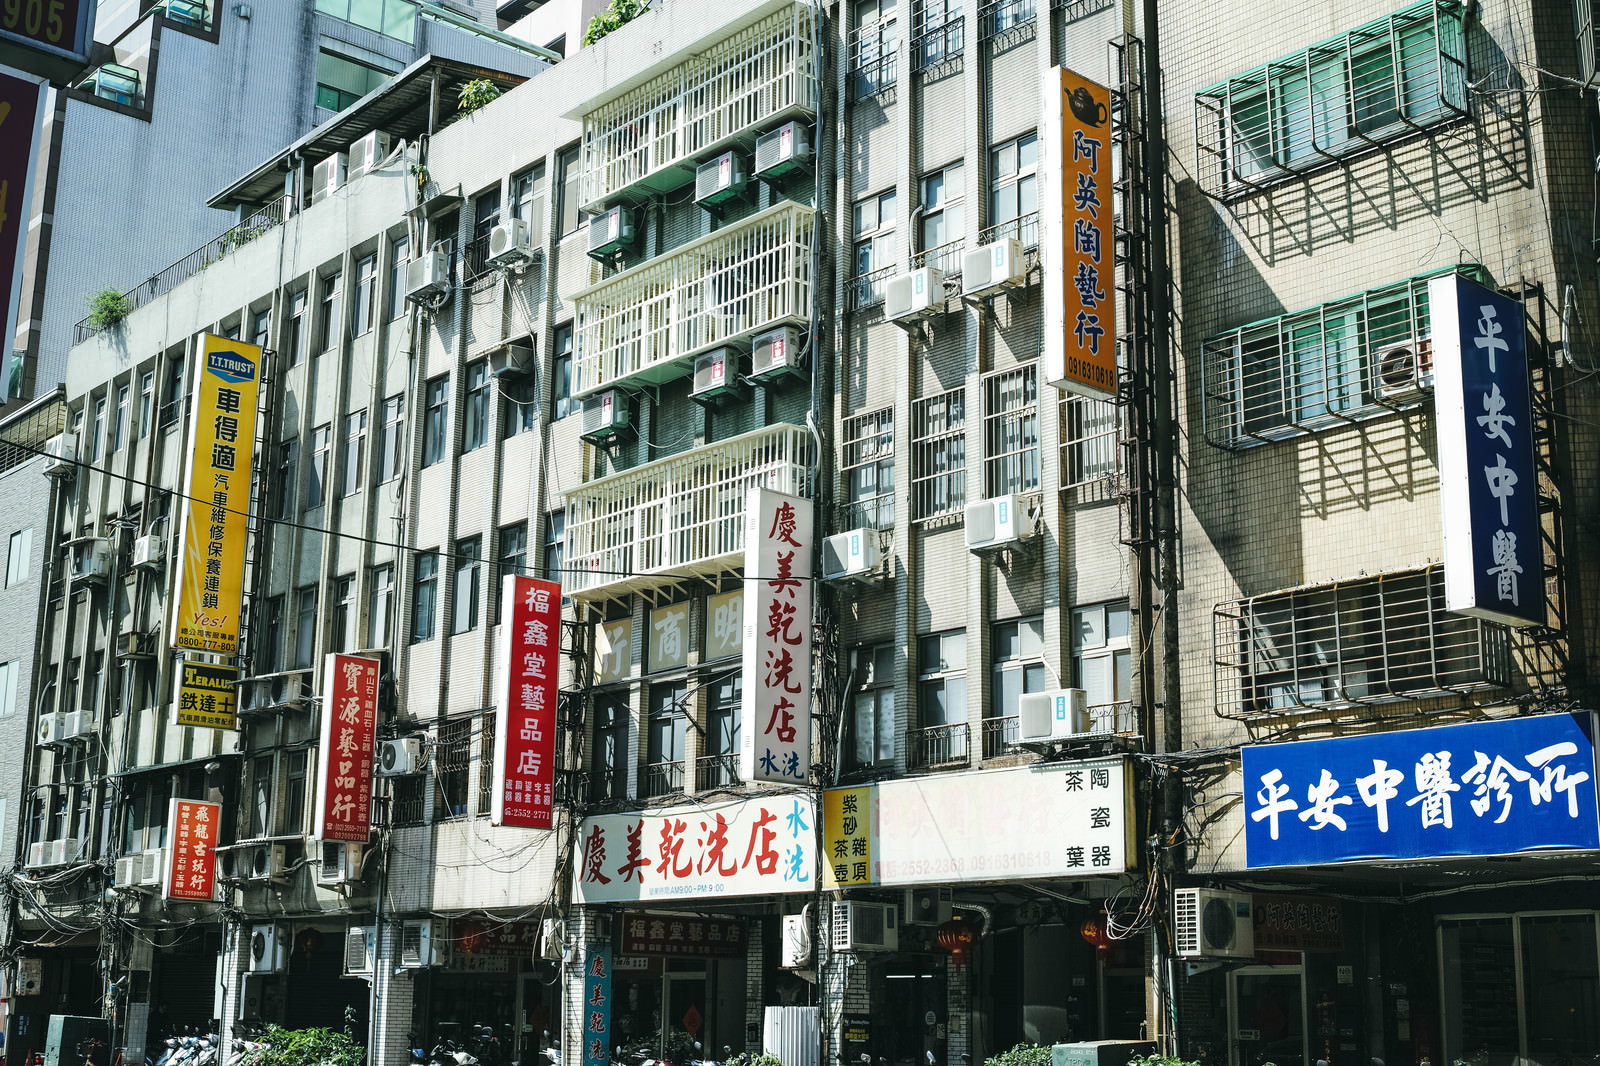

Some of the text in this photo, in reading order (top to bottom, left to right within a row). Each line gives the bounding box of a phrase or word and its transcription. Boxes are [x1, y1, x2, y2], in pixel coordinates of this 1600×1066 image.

[1072, 129, 1105, 356] 阿英陶藝行
[1068, 356, 1114, 387] 0916310618
[211, 387, 241, 471] 車得適
[1473, 304, 1524, 607] 平安中醫
[202, 473, 230, 610] 汽車維修保養連鎖
[178, 637, 235, 652] 0800-777-803
[193, 612, 227, 628] Yes!
[764, 501, 802, 744] 慶美乾洗店
[517, 587, 550, 776] 福鑫堂藝品店
[332, 661, 364, 823] 寶源藝品行
[759, 747, 804, 780] 水洗
[1090, 769, 1111, 867] 陶瓷器
[1250, 741, 1590, 841] 平安中醫診所
[190, 806, 210, 890] 飛龍古玩行
[579, 807, 780, 885] 慶美乾洗店
[783, 799, 810, 884] 水洗
[852, 836, 867, 882] 雜項
[589, 955, 607, 1066] 慶美乾洗
